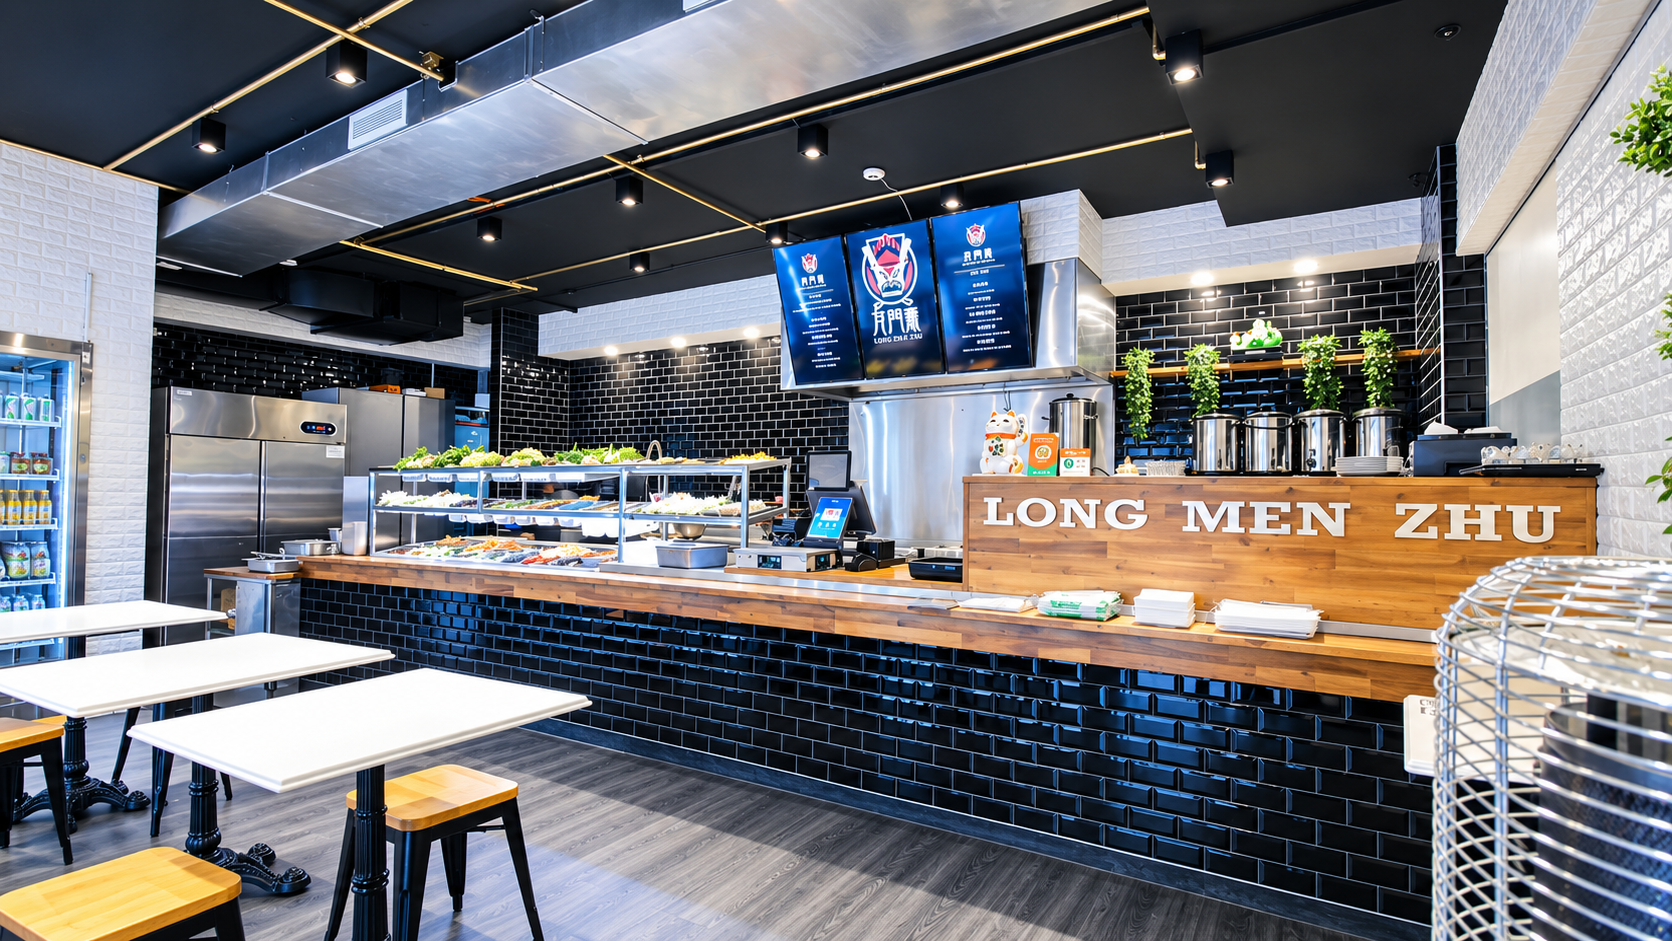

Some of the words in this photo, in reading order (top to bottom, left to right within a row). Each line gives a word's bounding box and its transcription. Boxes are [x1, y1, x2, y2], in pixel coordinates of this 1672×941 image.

[983, 497, 1148, 531] LONG
[1182, 501, 1351, 537] MEN
[1395, 503, 1561, 543] ZHU
